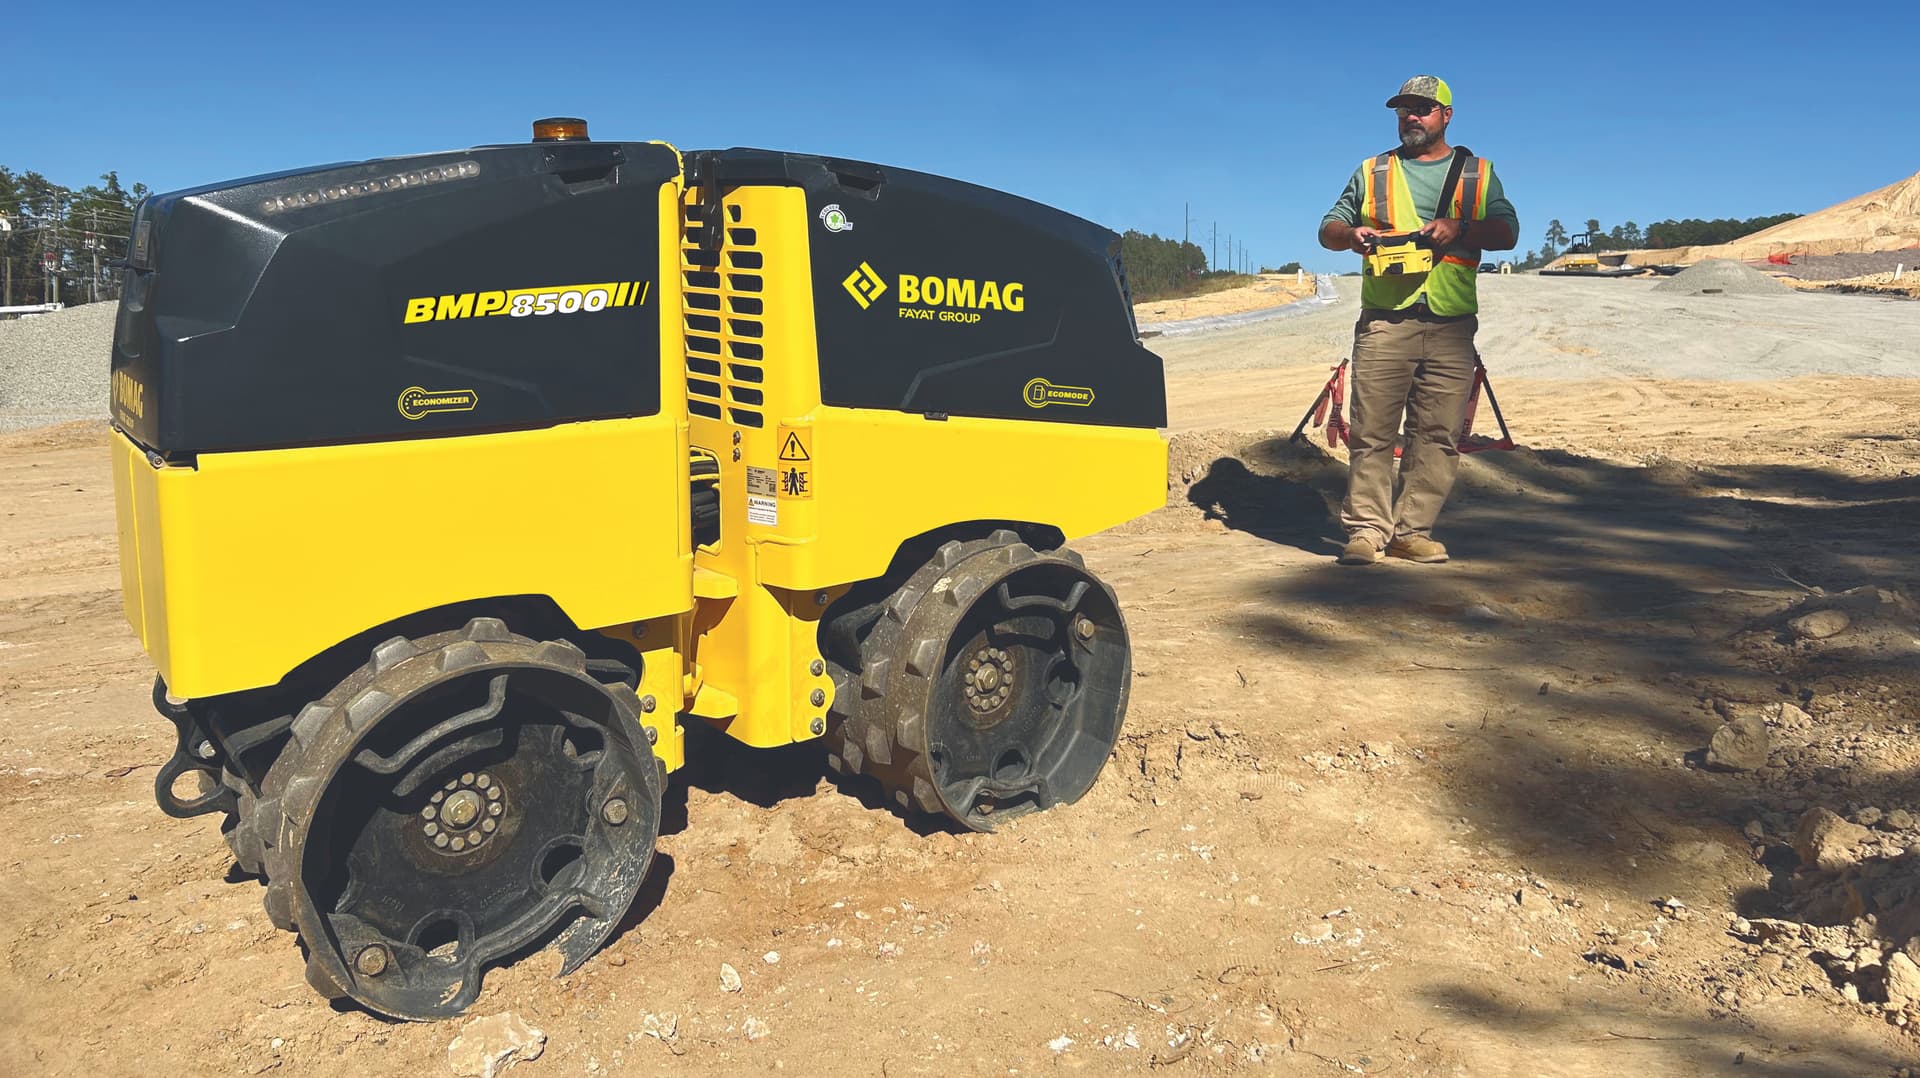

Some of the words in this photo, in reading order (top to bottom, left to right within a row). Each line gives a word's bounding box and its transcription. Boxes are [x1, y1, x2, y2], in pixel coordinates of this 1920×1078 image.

[898, 274, 1025, 312] BOMAG
[898, 308, 936, 321] FAYAT
[938, 311, 981, 324] GROUP
[412, 396, 470, 407] ECONOMIZER
[1047, 390, 1089, 401] ECOMODE
